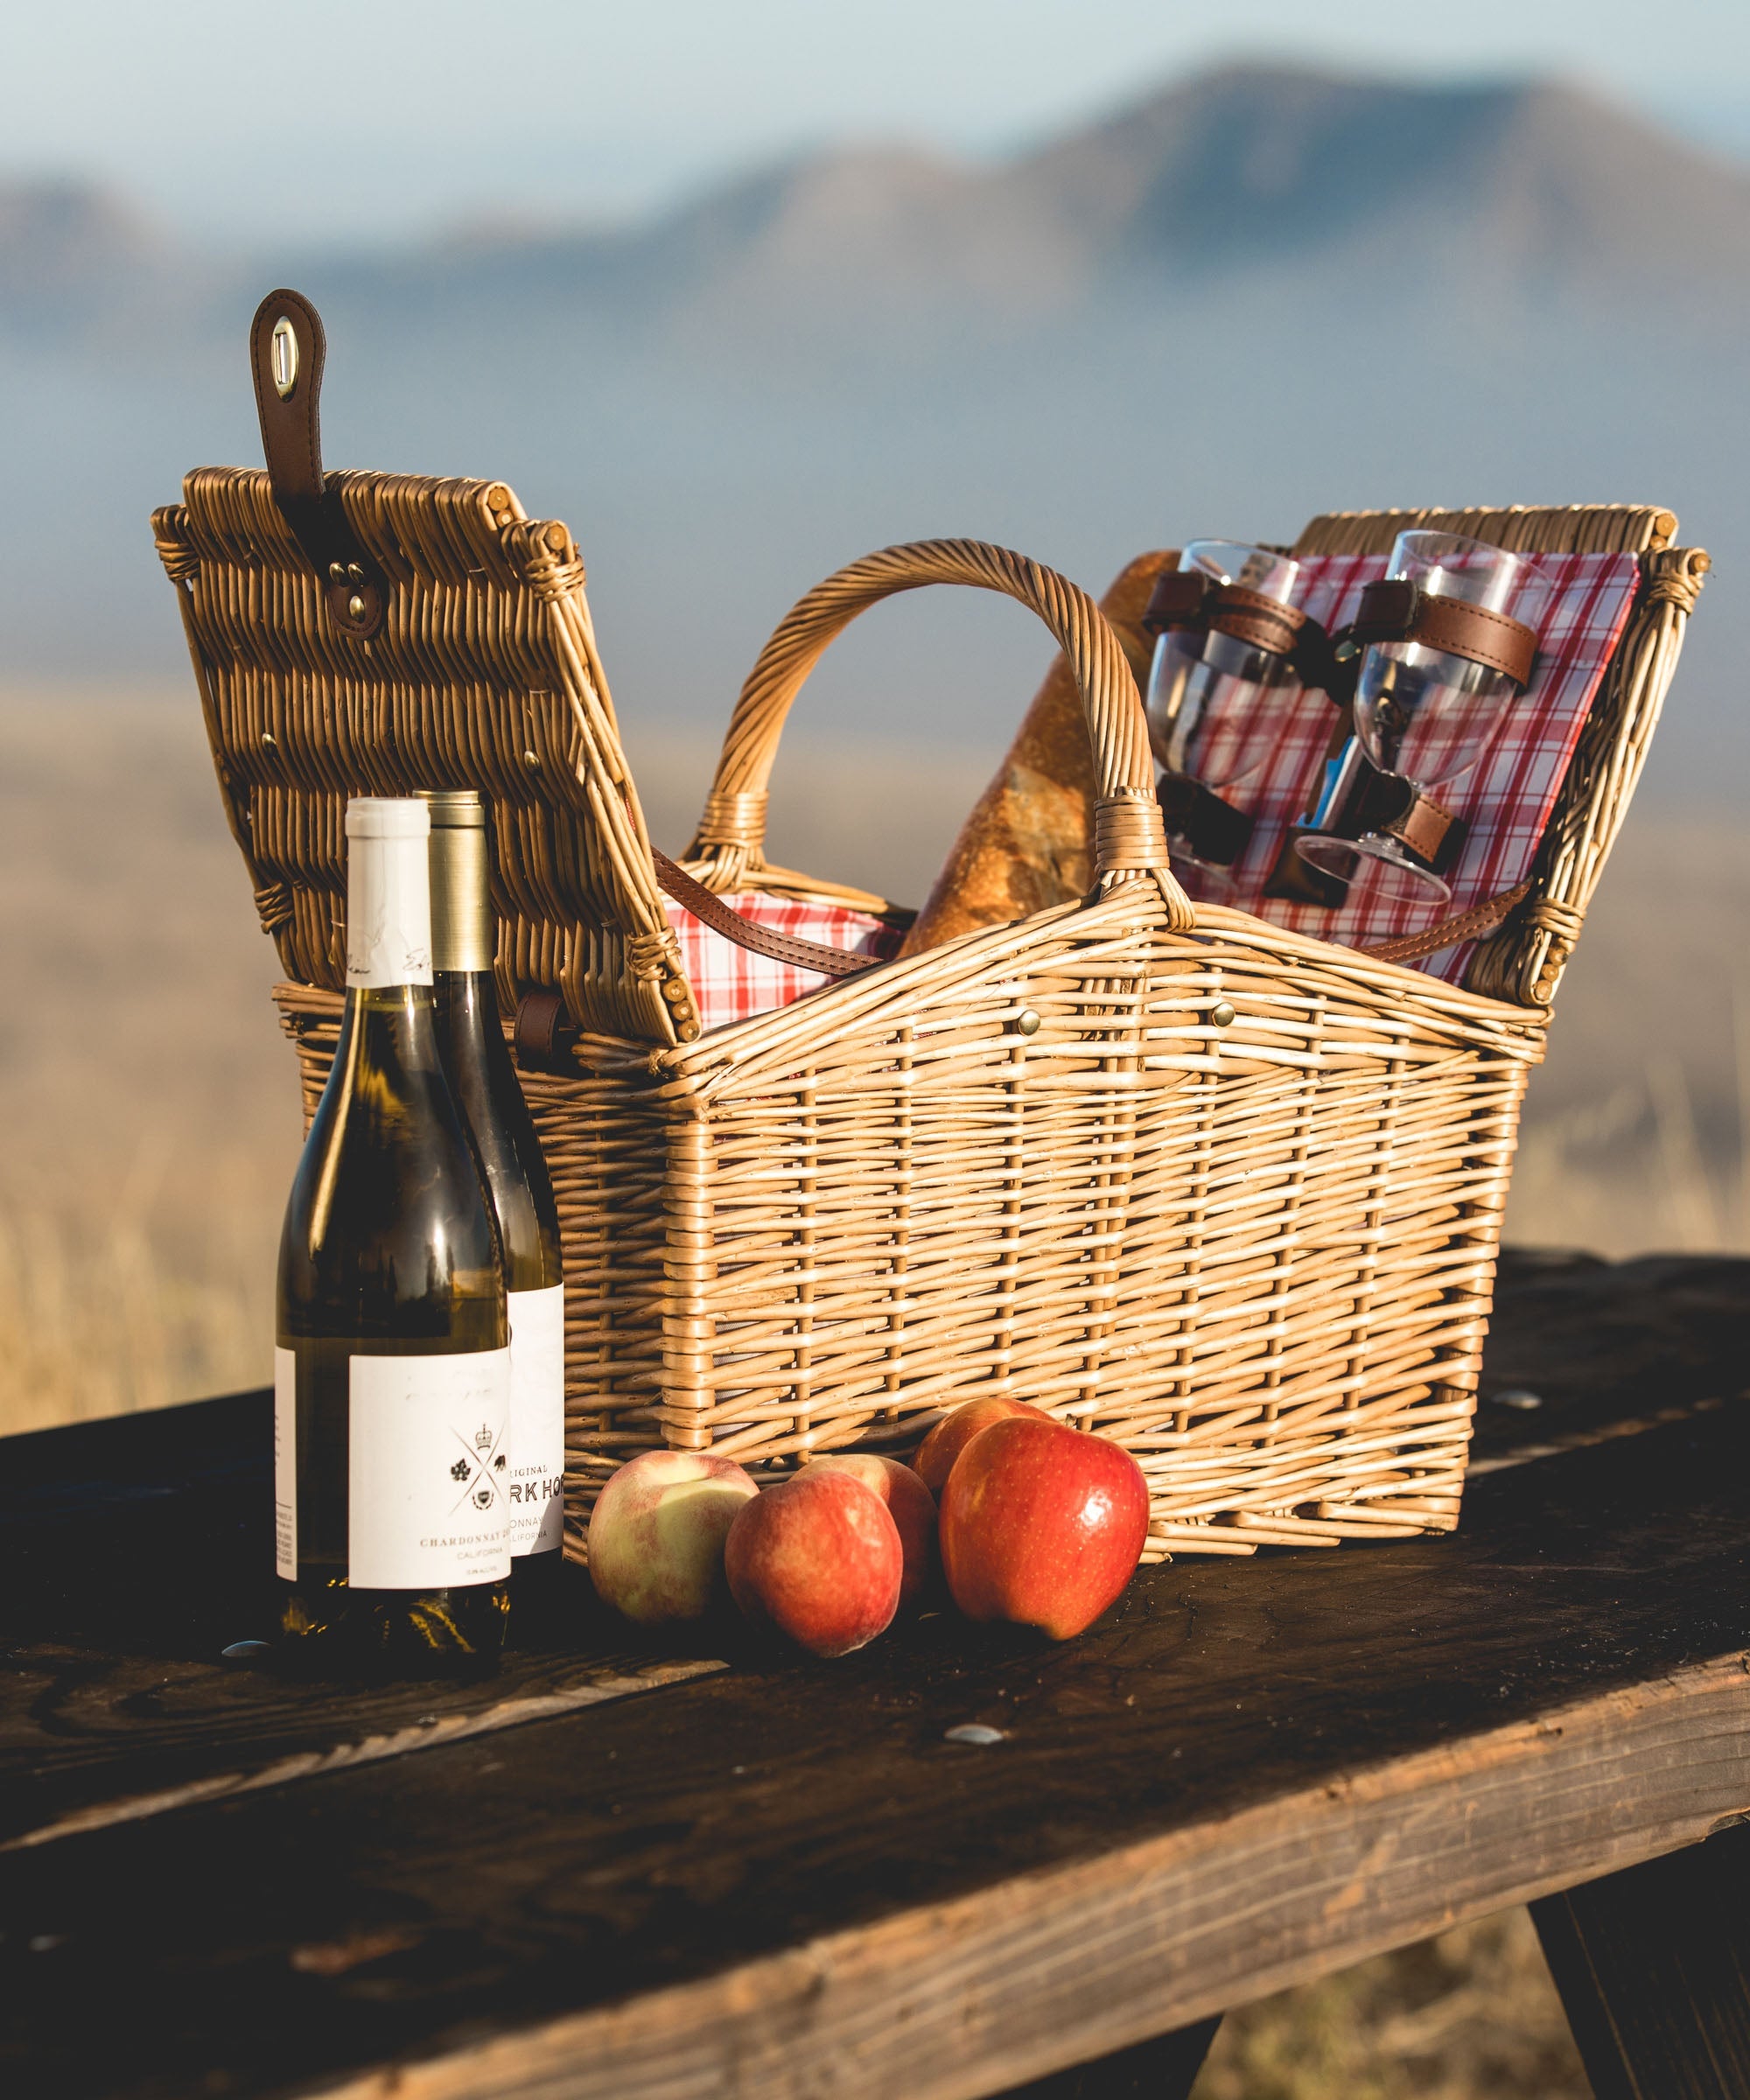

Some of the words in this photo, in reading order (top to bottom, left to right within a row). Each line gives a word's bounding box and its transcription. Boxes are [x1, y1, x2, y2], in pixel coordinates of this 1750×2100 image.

[510, 1482, 537, 1503] RK
[420, 1531, 500, 1547] CHARDONNAY
[511, 1531, 547, 1542] LIFORNIA
